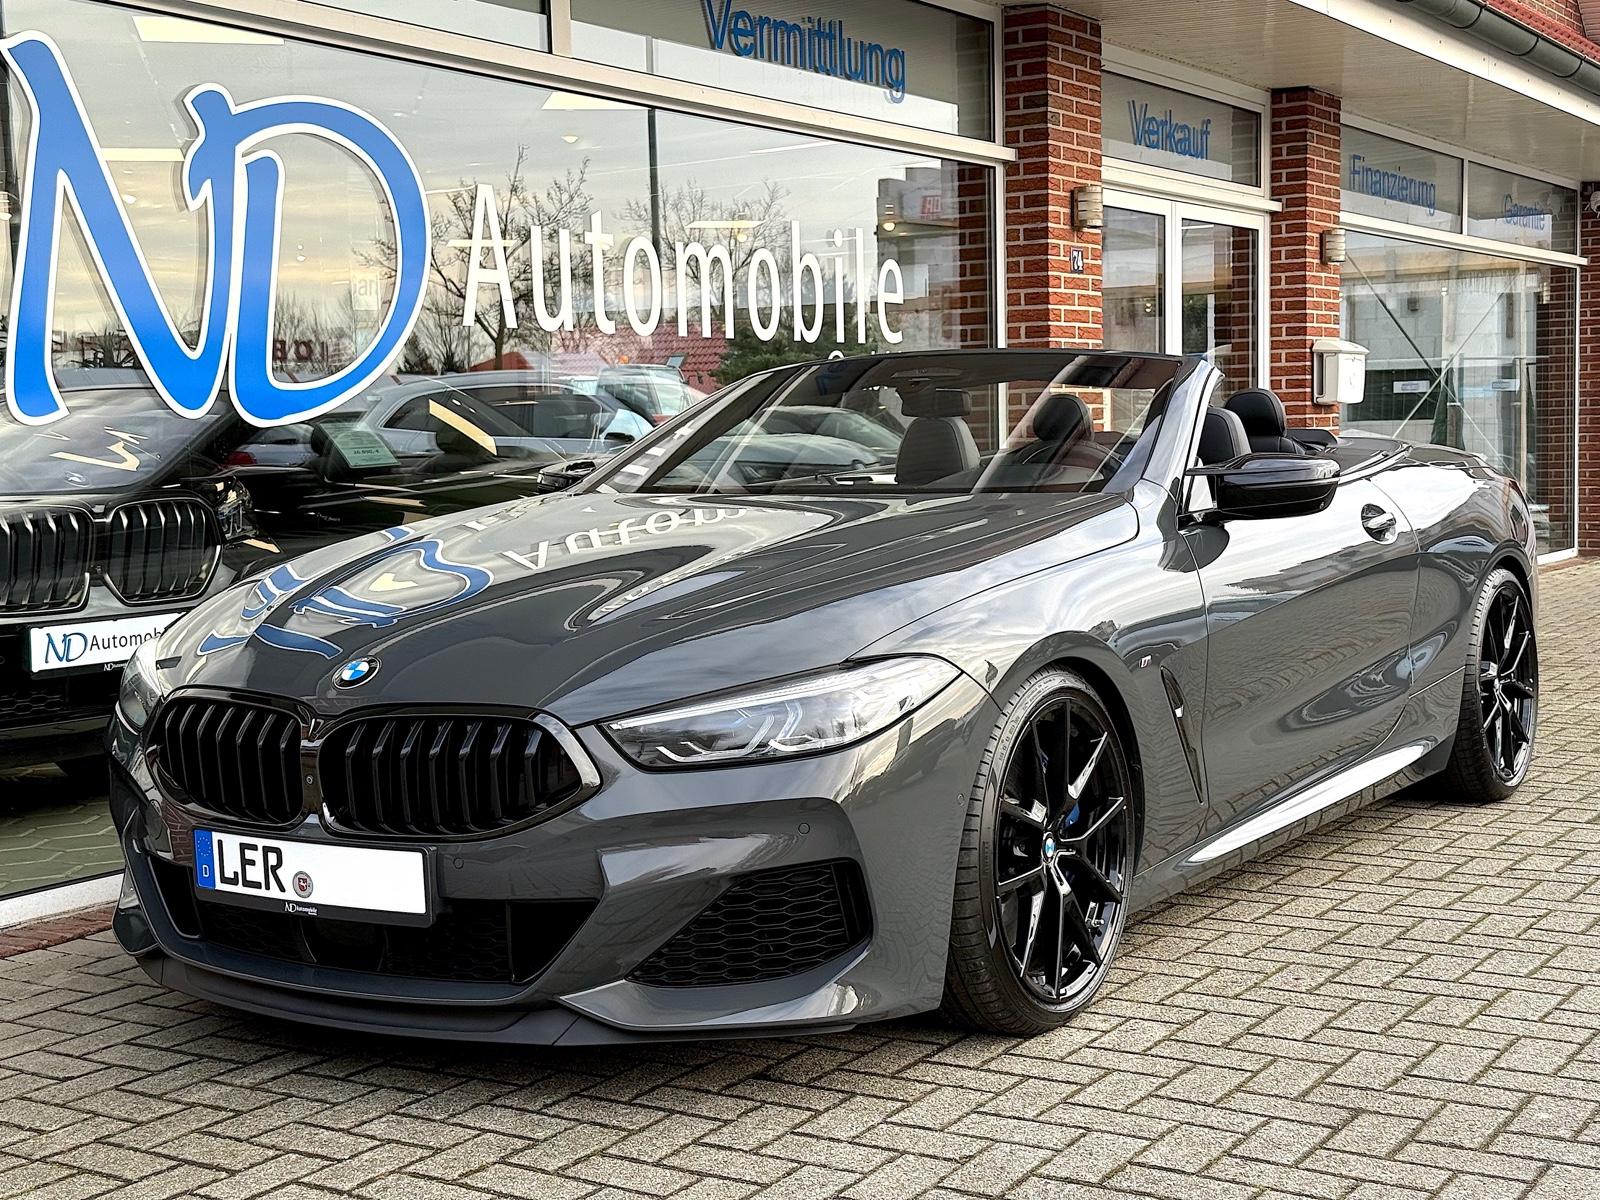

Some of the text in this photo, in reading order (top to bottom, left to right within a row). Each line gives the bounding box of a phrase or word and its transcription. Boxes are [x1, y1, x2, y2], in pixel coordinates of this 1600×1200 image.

[705, 0, 905, 103] Vermittlung
[1130, 99, 1212, 160] Verkauf
[1351, 153, 1436, 217] Finanzierung
[1504, 193, 1545, 231] Garantie
[0, 30, 905, 427] ND Automobile
[45, 632, 88, 664] ND
[202, 839, 286, 893] D LER
